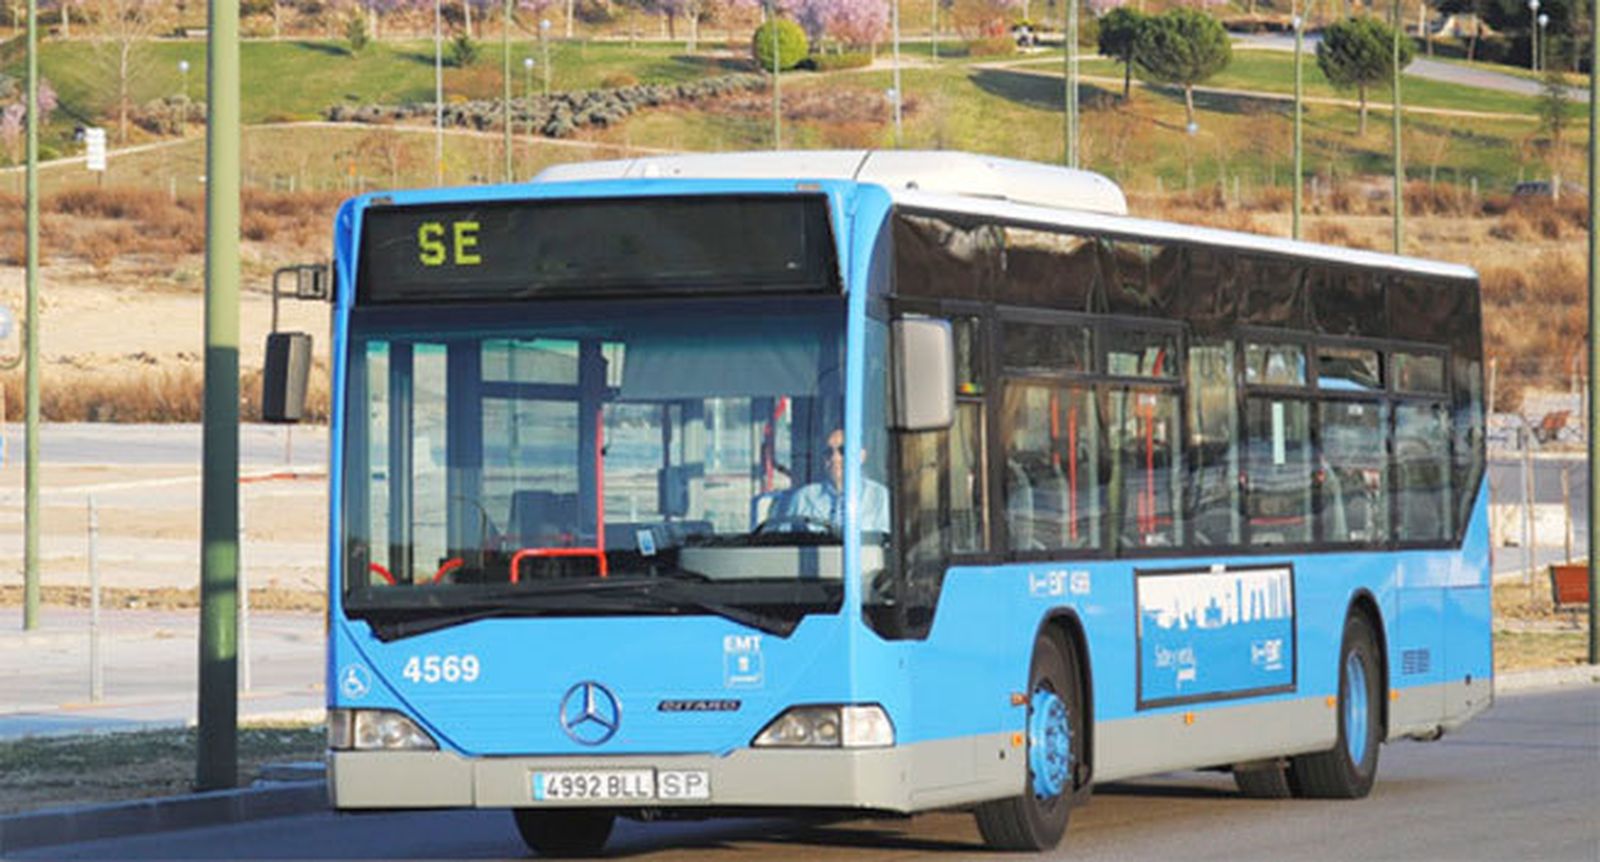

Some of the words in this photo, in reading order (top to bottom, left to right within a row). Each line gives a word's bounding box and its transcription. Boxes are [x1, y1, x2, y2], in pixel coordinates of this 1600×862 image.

[417, 221, 482, 266] SE
[723, 635, 762, 651] EMT
[402, 654, 481, 684] 4569
[546, 776, 601, 799] 4992
[607, 775, 649, 797] BLL
[662, 773, 703, 797] SP
